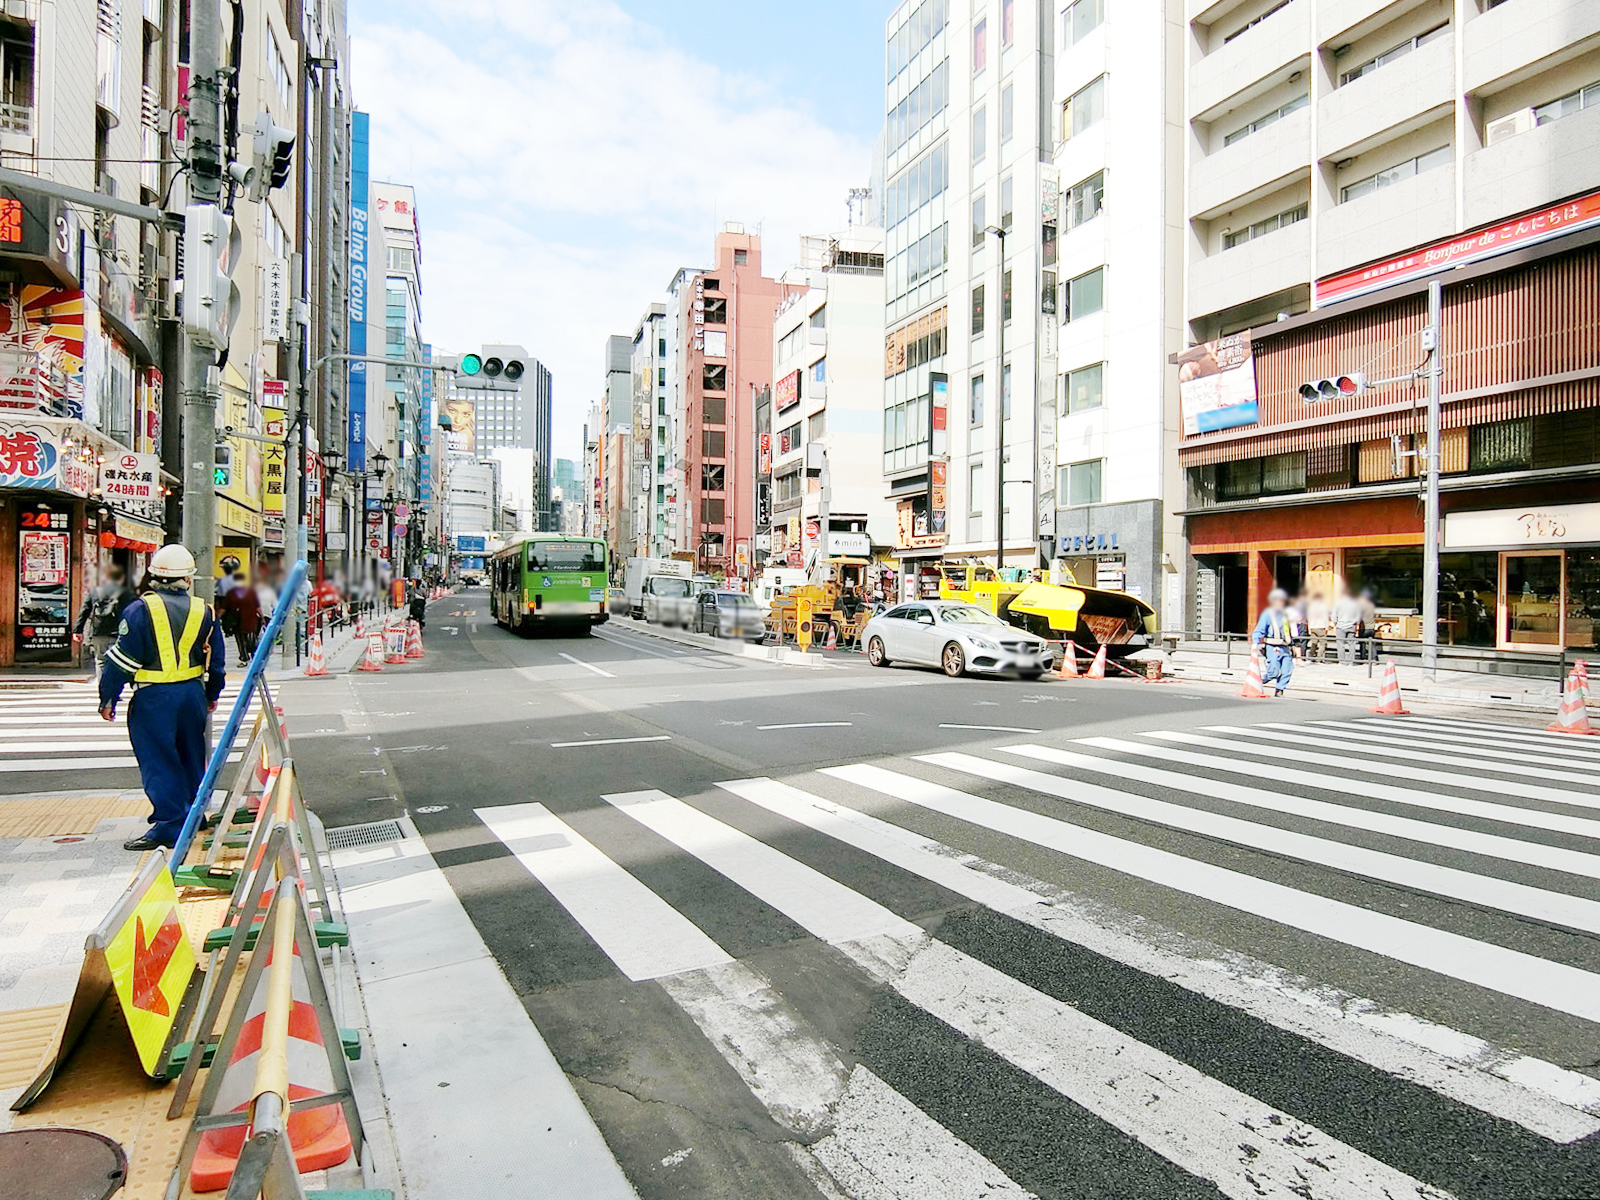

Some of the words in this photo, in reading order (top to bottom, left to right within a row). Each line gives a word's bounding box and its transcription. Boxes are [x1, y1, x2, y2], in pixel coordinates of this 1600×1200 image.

[351, 206, 368, 263] Being
[1424, 239, 1476, 266] Bonjour
[1479, 231, 1495, 247] de
[1501, 204, 1579, 240] こんにちは
[350, 265, 367, 322] Group
[104, 469, 153, 482] 磯丸水産
[107, 483, 149, 496] 24時間
[267, 446, 283, 494] 大黒屋
